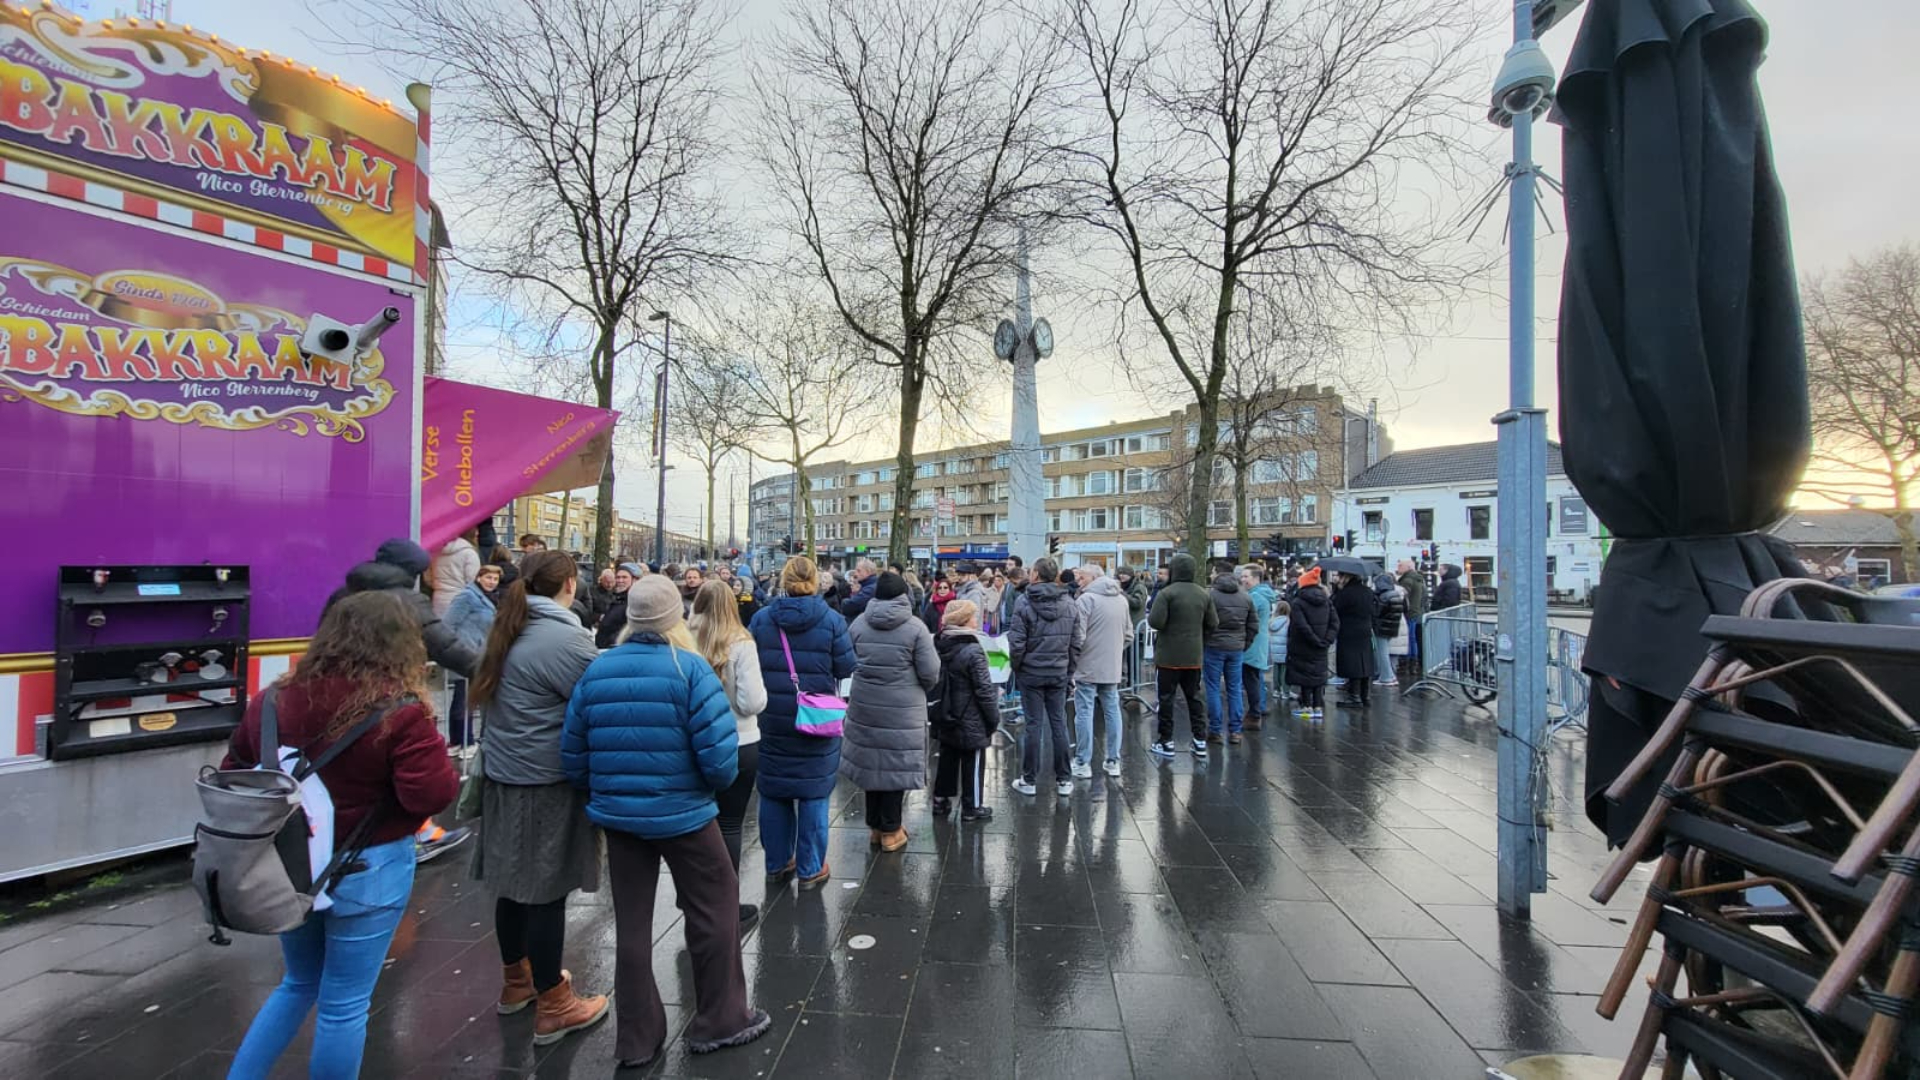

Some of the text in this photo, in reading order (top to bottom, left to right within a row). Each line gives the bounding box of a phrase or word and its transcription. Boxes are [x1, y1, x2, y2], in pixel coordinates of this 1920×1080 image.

[196, 172, 354, 216] Nico Sterrenberg
[114, 280, 164, 301] Sinds
[0, 296, 91, 322] Schiedam
[0, 313, 354, 392] BAKKRAAM
[180, 382, 320, 402] Nico Sterrenberg
[547, 412, 576, 435] Nico
[421, 425, 440, 483] Verse
[455, 409, 475, 507] Oliebollen
